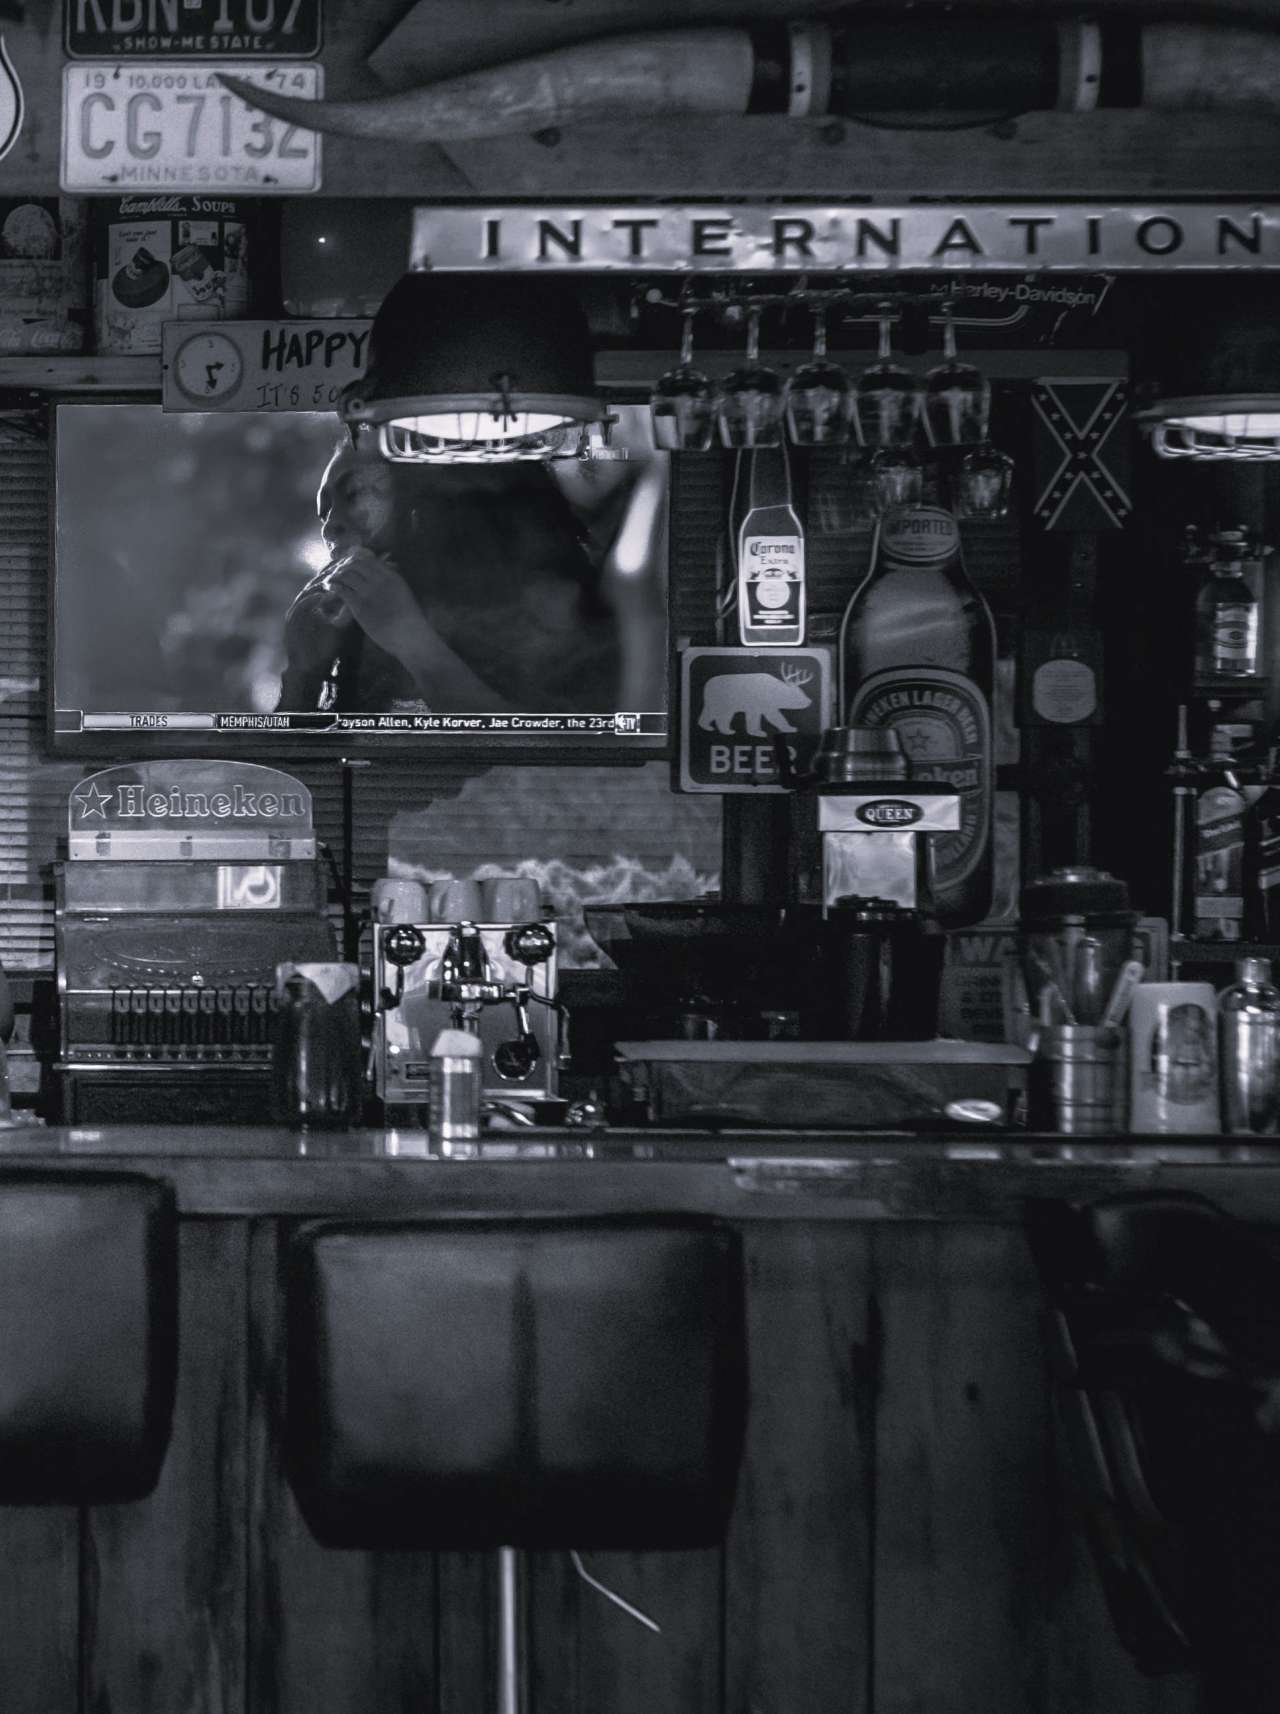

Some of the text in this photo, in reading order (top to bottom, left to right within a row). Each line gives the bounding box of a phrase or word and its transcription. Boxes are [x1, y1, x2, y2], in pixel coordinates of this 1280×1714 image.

[123, 35, 265, 49] SHOW-ME STATE
[84, 74, 106, 89] 19
[276, 73, 305, 89] 74
[121, 166, 258, 183] MINNESOTA
[486, 217, 1261, 259] INTERNATION
[261, 328, 370, 372] HAPPY
[750, 541, 796, 557] Corona
[130, 714, 290, 728] TRADES MEMPHIS/UTAH
[337, 717, 376, 729] ayson
[378, 717, 412, 729] Allen,
[414, 718, 440, 729] Kyle
[442, 717, 486, 729] Korver,
[488, 717, 508, 729] Jae
[510, 717, 564, 729] Crowder,
[118, 785, 307, 818] Heineken
[864, 808, 914, 823] QUEEN
